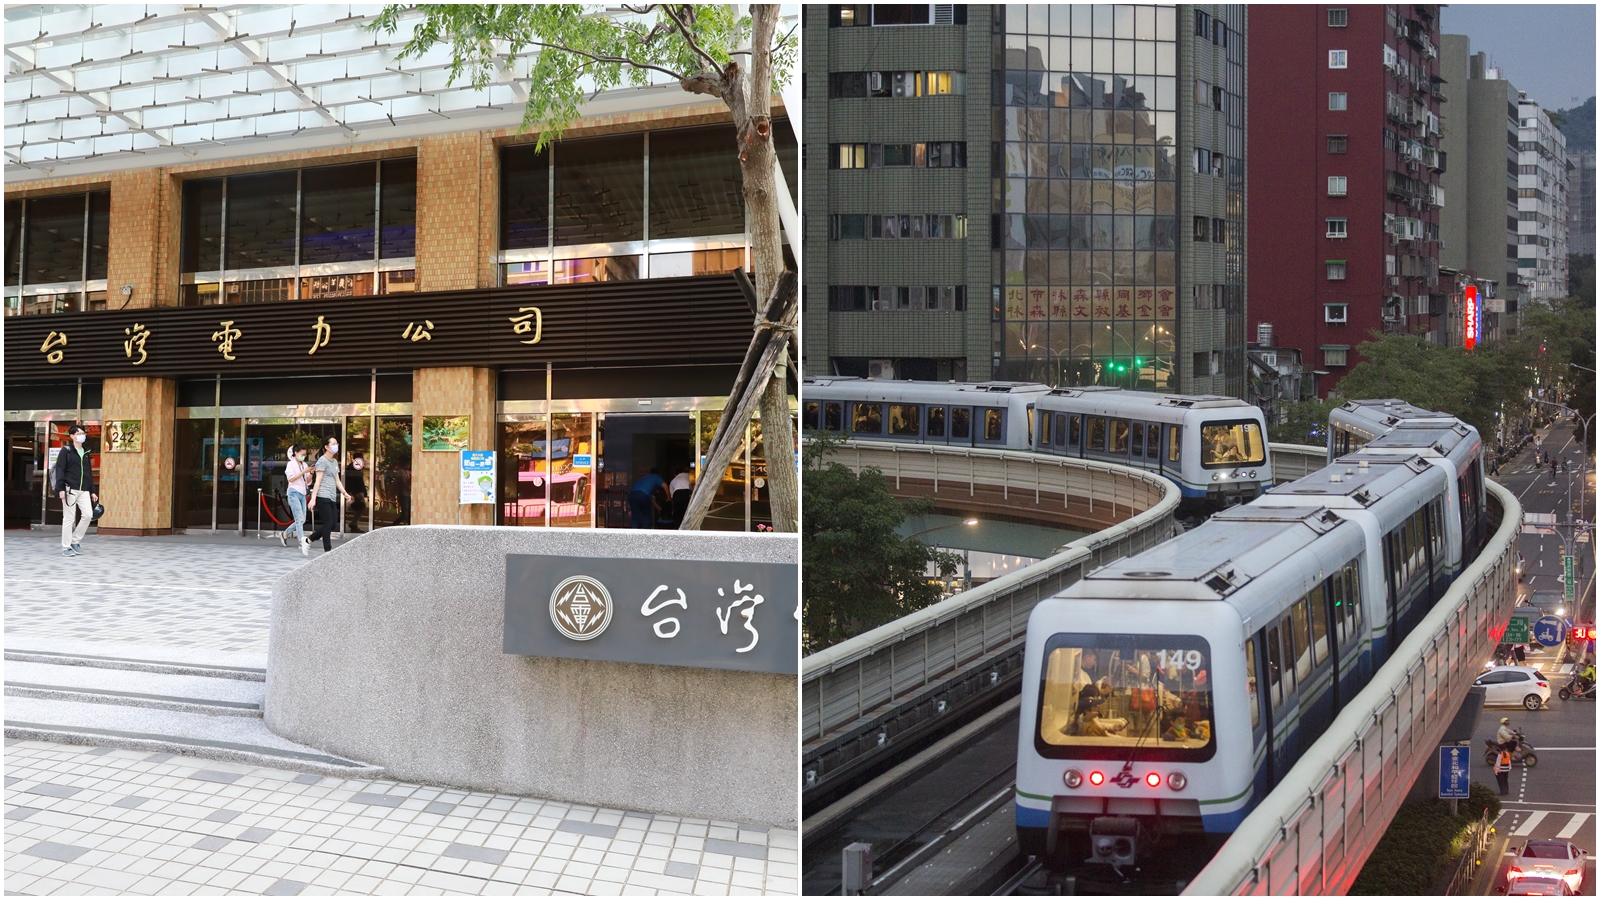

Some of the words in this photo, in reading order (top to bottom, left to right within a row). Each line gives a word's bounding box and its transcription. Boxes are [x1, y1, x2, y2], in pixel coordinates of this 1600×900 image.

[40, 306, 542, 366] 台灣電力公司
[1467, 297, 1475, 339] SHARP
[112, 431, 135, 443] 242
[640, 579, 798, 653] 台灣
[1156, 649, 1202, 670] 149
